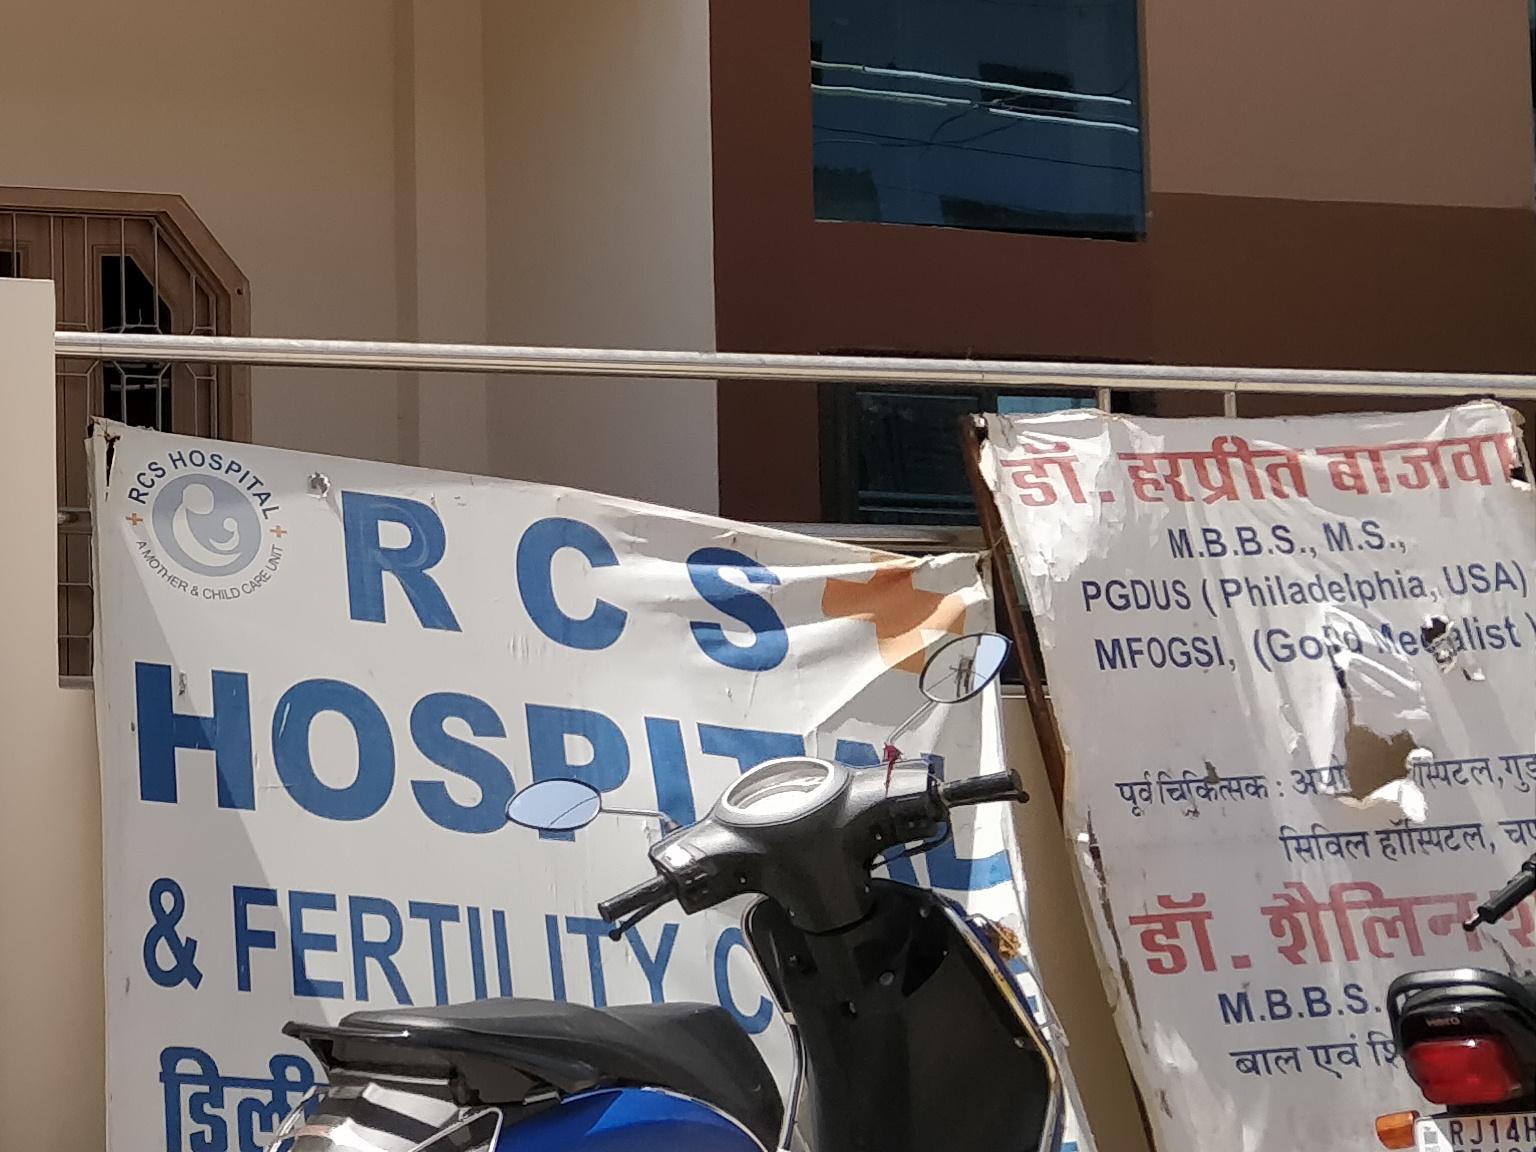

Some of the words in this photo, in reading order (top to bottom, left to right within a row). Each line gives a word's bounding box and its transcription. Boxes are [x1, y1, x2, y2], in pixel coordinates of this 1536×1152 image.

[128, 461, 167, 505] RCS
[168, 450, 279, 520] HOSPITAL
[1119, 435, 1310, 505] हरप्रीत
[1168, 525, 1317, 560] M.B.B.S.,
[1323, 520, 1406, 554] M.S.,
[141, 550, 189, 592] MOTHER
[190, 585, 199, 597] &
[202, 587, 240, 600] CHILD
[241, 569, 272, 595] CARE
[265, 544, 283, 575] UNIT
[1082, 577, 1191, 612] PGDUS
[1442, 560, 1527, 598] USA)
[143, 877, 203, 990] &
[1229, 1046, 1303, 1079] बाल
[1307, 1033, 1362, 1079] एवं
